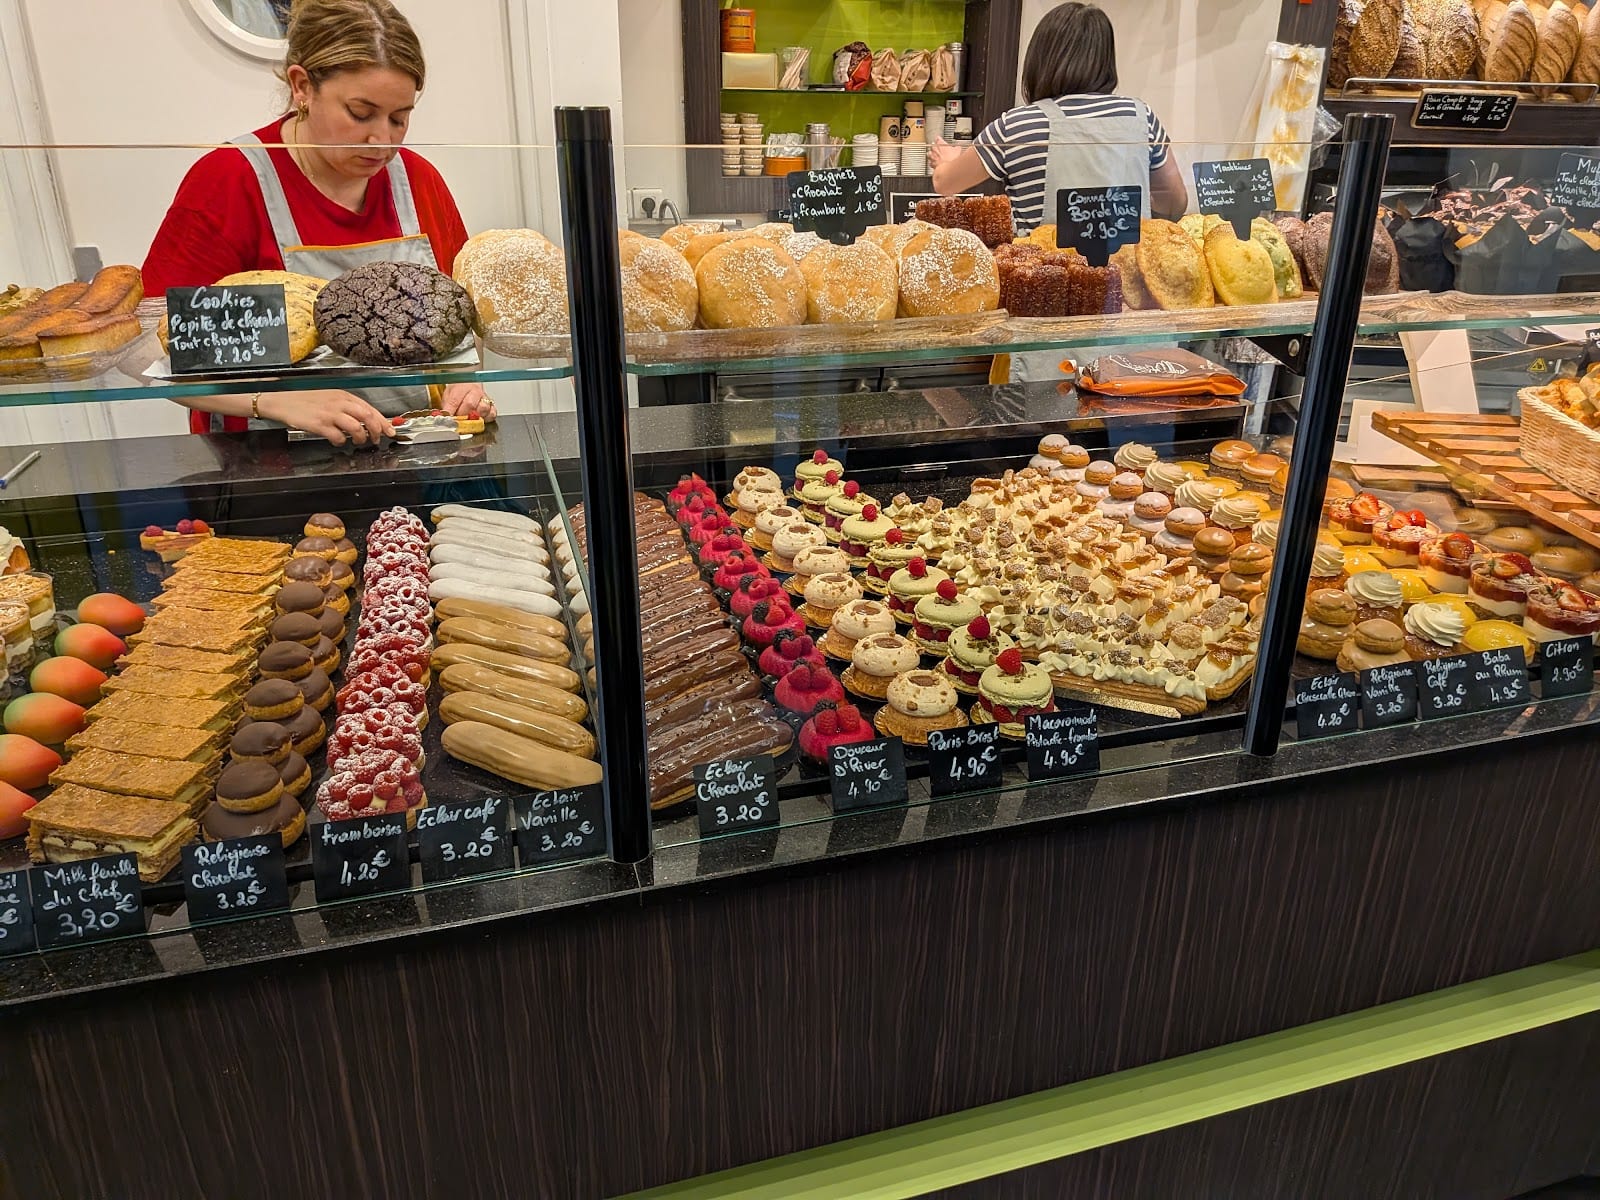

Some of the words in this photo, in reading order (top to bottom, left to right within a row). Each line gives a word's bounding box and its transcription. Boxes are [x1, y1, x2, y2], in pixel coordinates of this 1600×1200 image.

[807, 169, 857, 186] Beignets
[1559, 172, 1577, 183] Tout
[796, 184, 843, 199] Chocolat
[799, 202, 846, 218] framboise
[190, 286, 255, 310] Cookies
[221, 310, 236, 330] de
[170, 335, 201, 351] Tout
[203, 329, 260, 347] chocolat
[1482, 649, 1511, 666] Baba
[1546, 642, 1580, 658] Citron
[1475, 671, 1490, 681] au
[833, 742, 888, 760] Douceur
[697, 771, 766, 802] Chocolat
[520, 806, 579, 830] Vanille
